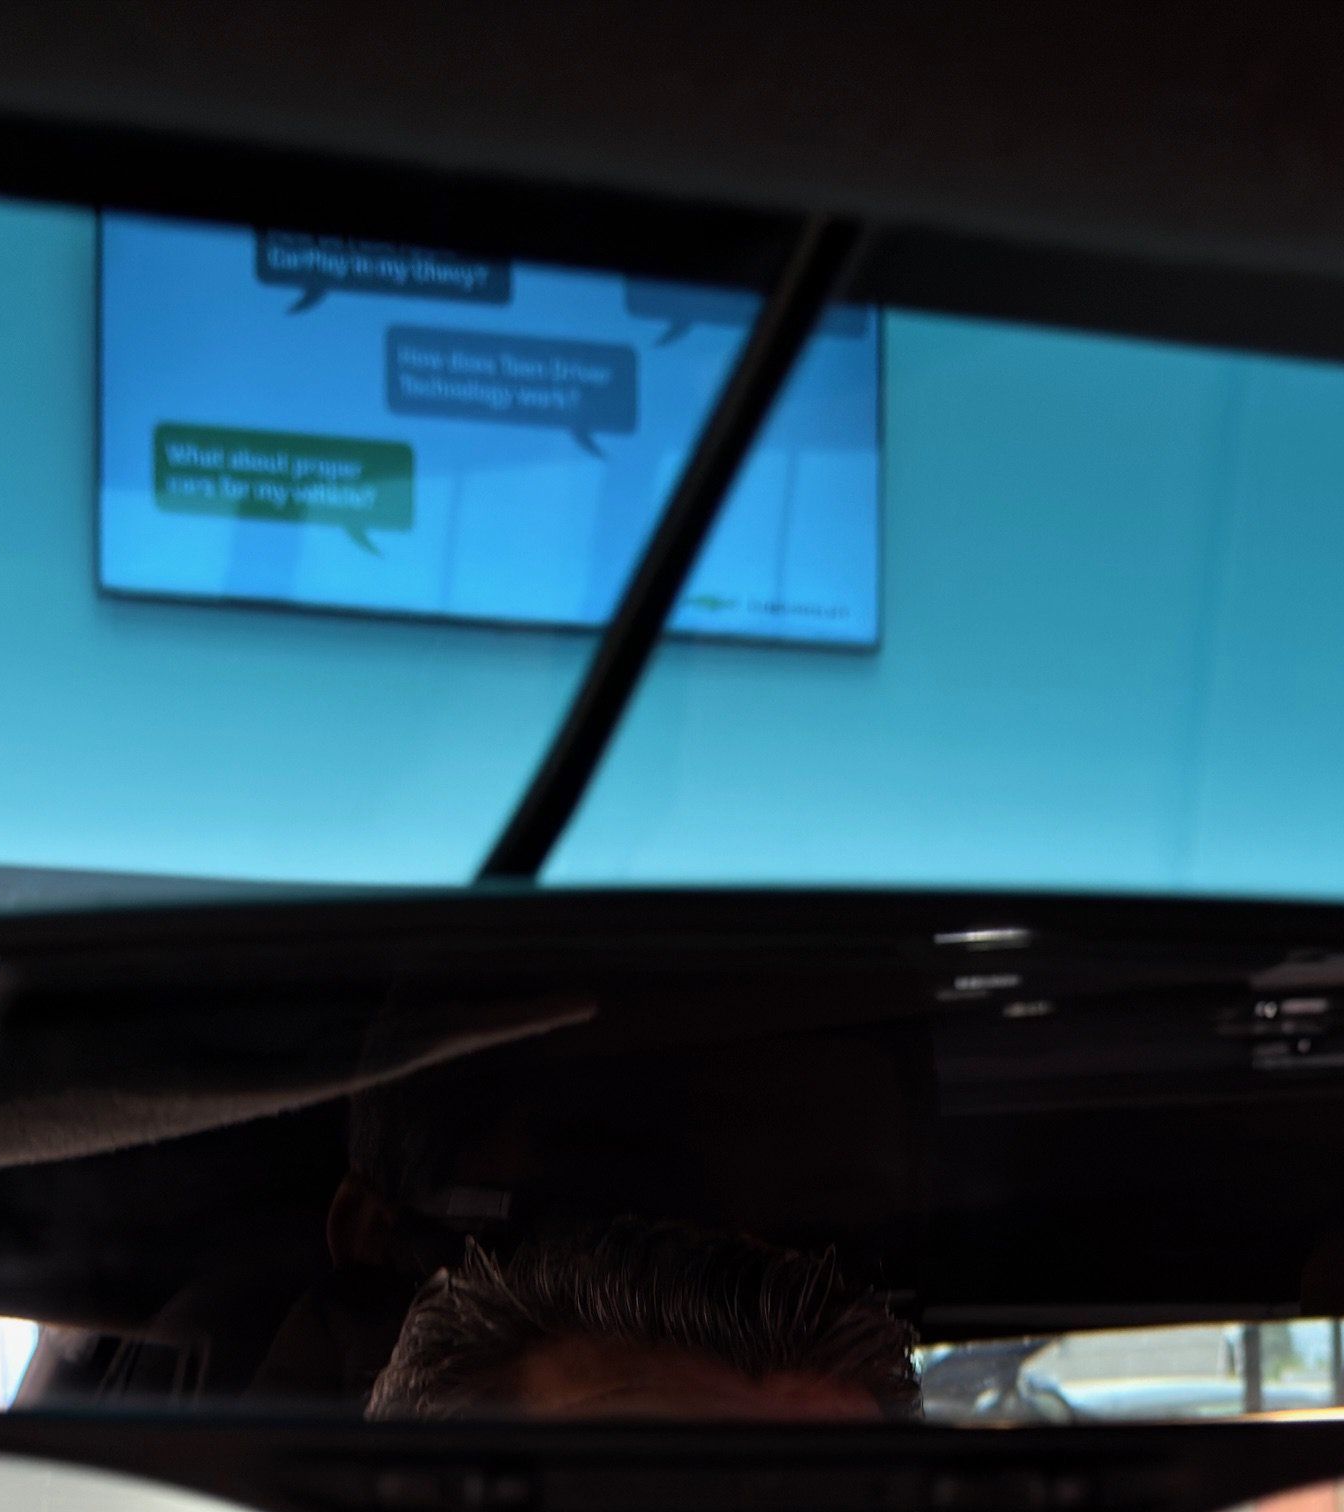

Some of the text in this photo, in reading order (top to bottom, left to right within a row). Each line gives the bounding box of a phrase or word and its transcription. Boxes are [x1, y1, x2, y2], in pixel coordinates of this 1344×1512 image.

[265, 246, 348, 279] CarPlay
[379, 259, 407, 285] my
[399, 373, 513, 411] Technology
[165, 442, 362, 482] What about proper
[253, 481, 288, 508] my
